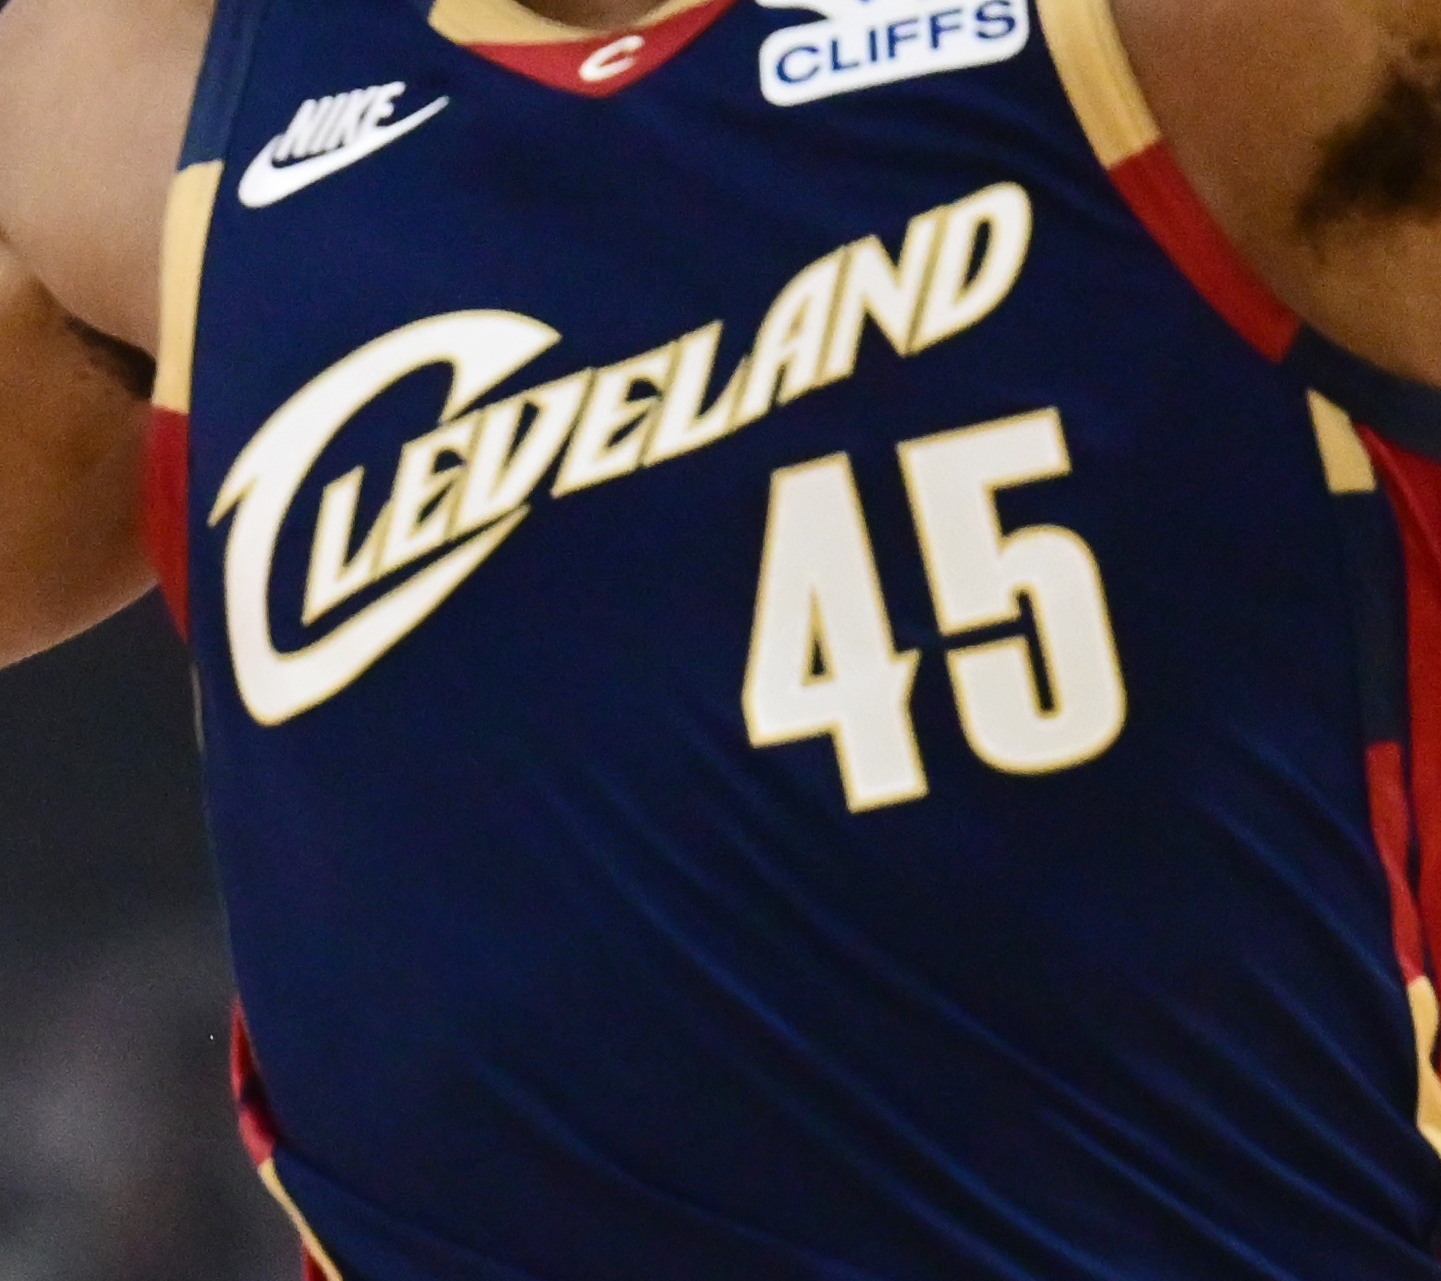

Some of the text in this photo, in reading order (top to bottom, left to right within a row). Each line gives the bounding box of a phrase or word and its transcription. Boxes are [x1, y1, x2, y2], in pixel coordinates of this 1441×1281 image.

[271, 80, 407, 162] NIKE
[208, 182, 1034, 725] CLEVELAND
[742, 406, 1127, 813] 45
